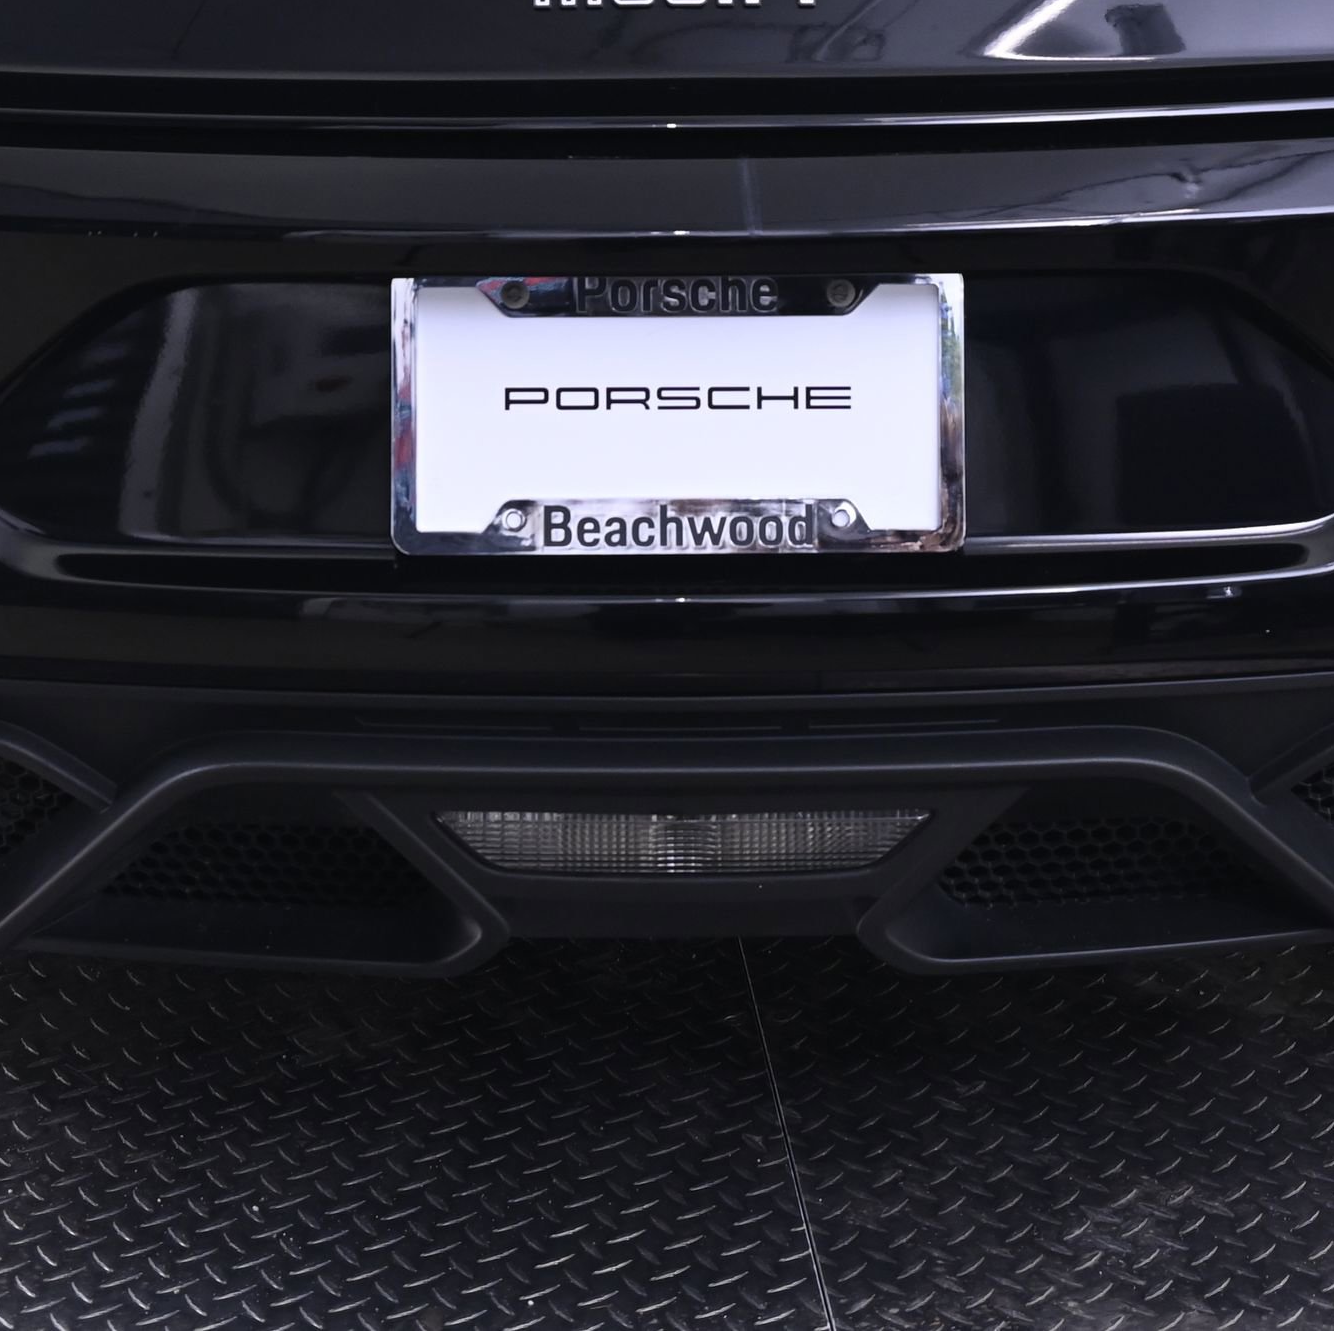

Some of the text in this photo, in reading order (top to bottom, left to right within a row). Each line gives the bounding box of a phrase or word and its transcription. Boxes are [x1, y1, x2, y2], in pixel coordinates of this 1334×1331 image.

[575, 276, 779, 313] Porsche
[504, 386, 851, 411] PORSCHE
[542, 504, 814, 547] Beachwood
